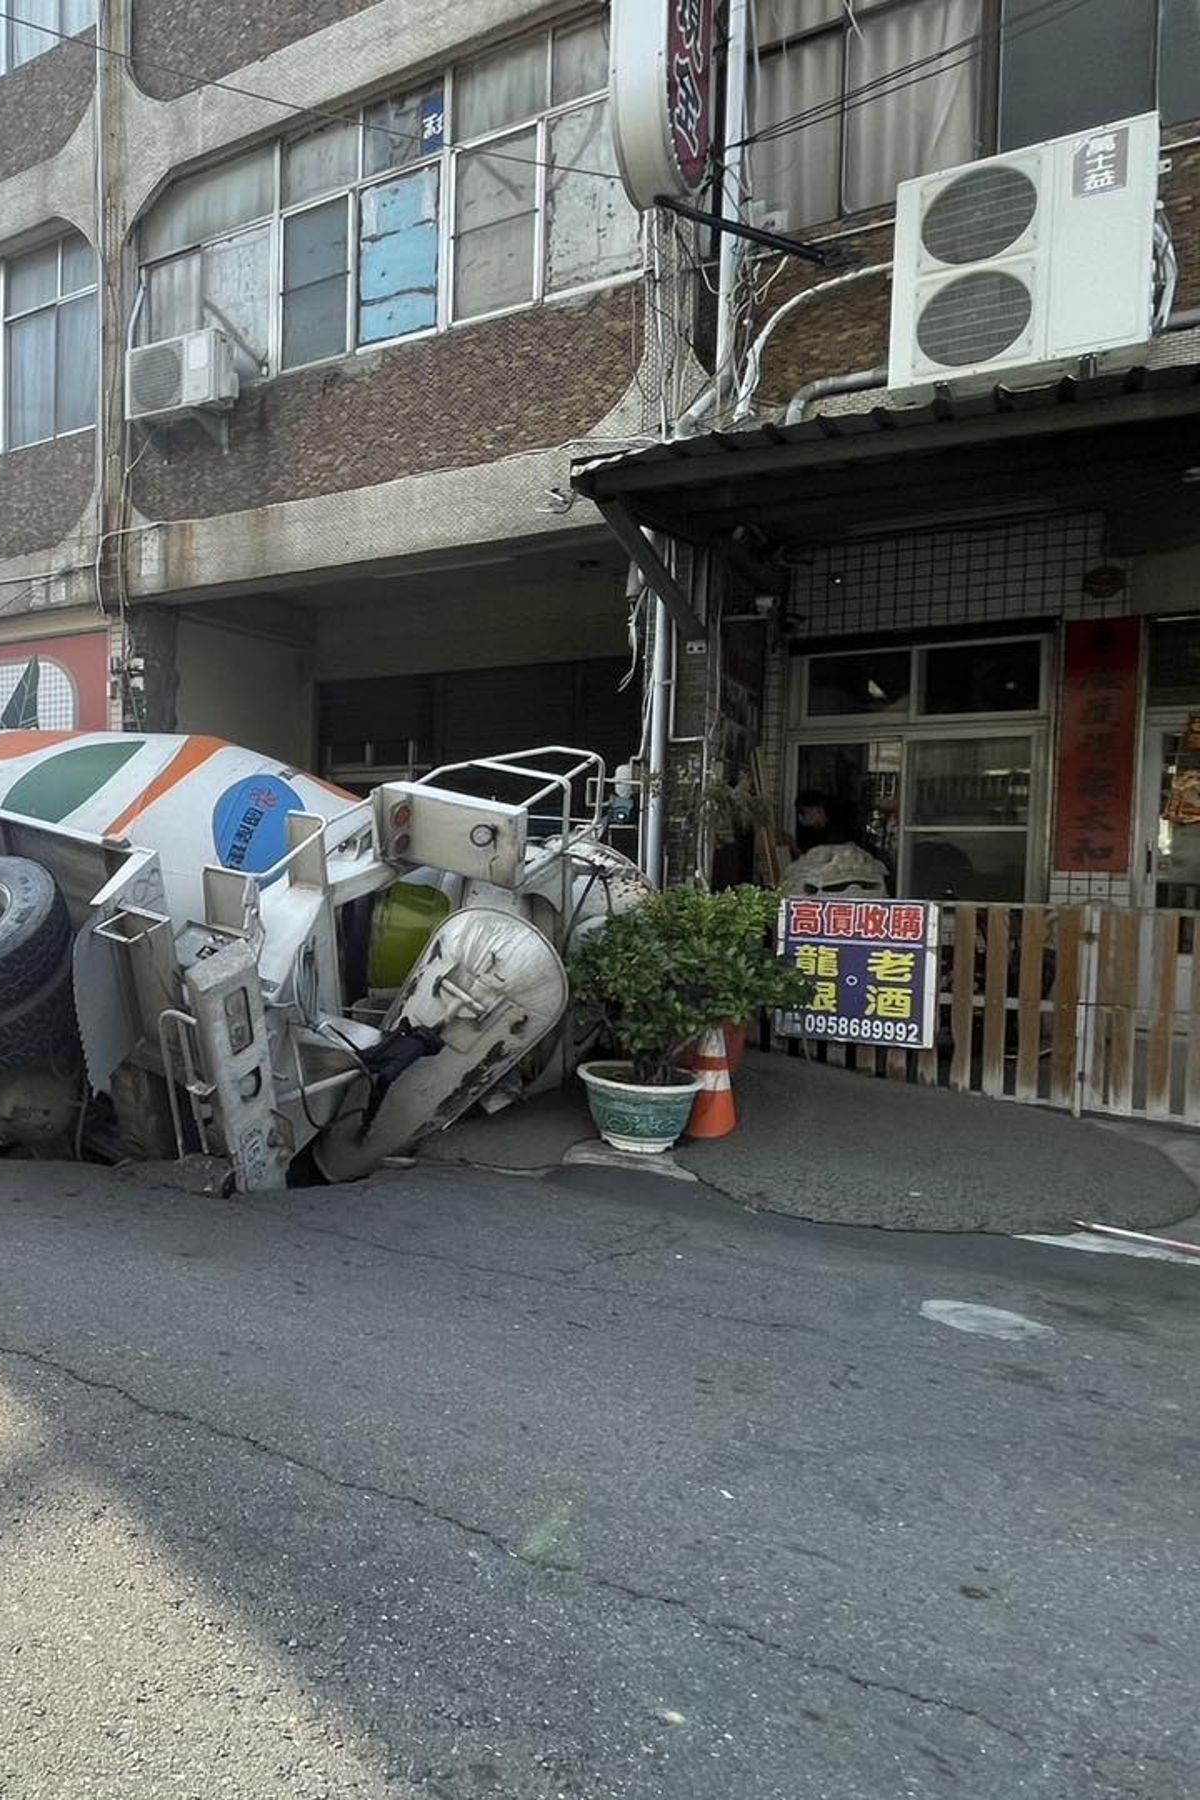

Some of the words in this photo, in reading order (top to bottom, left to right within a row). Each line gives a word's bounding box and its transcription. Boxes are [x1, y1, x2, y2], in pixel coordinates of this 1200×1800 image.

[789, 901, 924, 940] 高價收購
[865, 949, 916, 1019] 老酒
[804, 1014, 919, 1043] 0958689992
